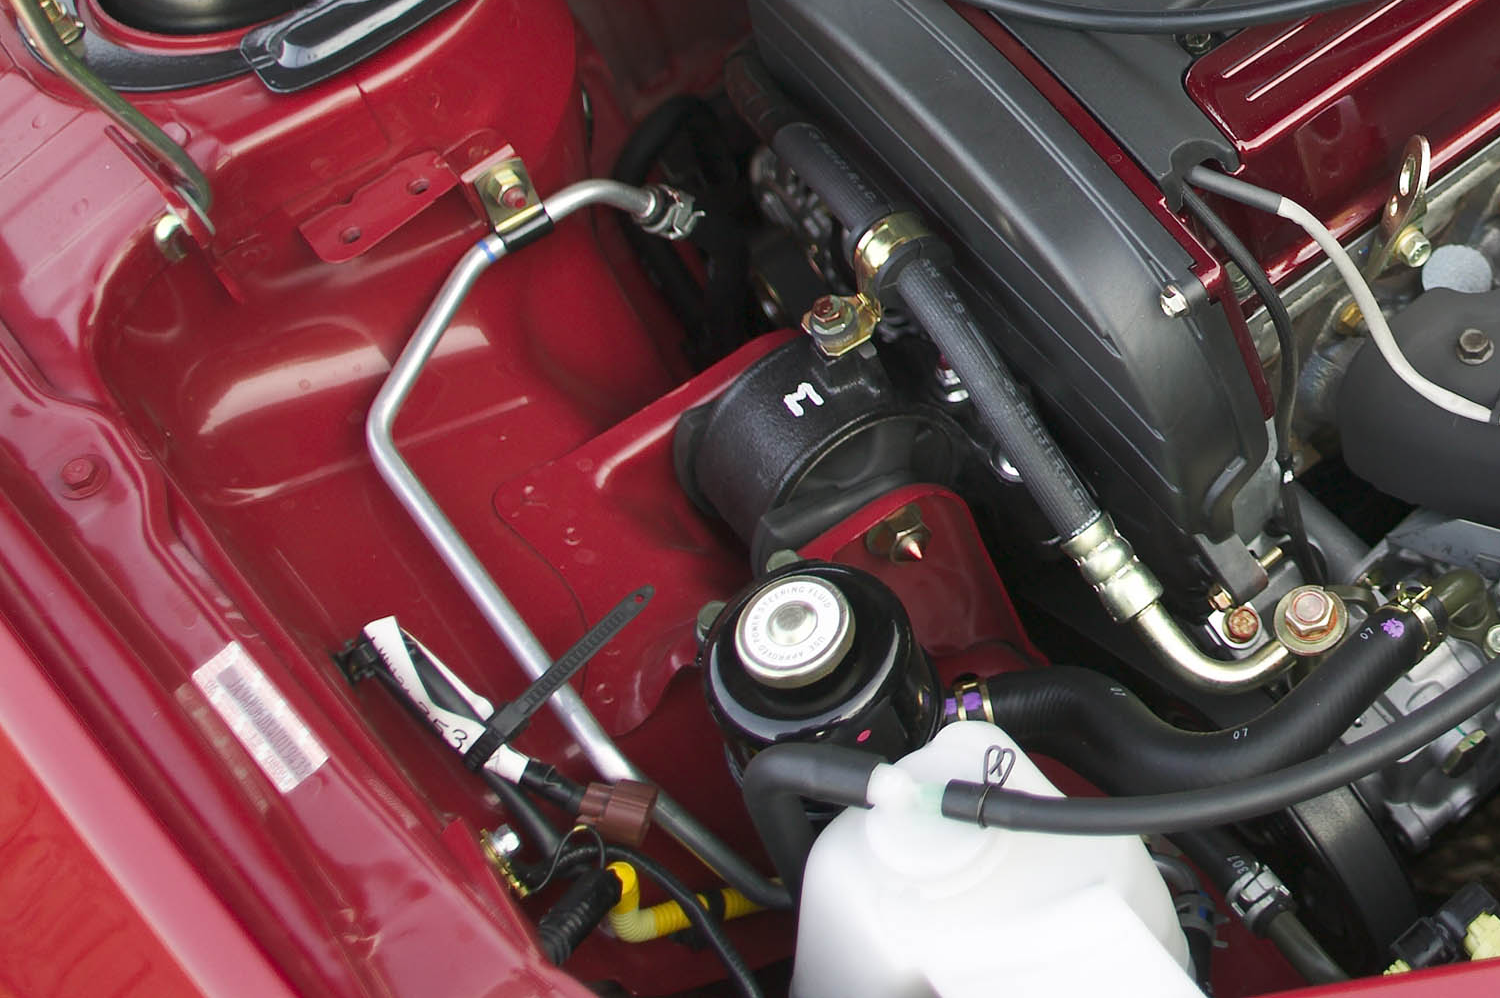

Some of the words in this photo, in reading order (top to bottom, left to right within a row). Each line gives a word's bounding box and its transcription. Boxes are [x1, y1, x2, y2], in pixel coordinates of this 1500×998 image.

[783, 382, 825, 417] M
[758, 586, 806, 612] STEERING
[807, 588, 832, 608] FLUID
[1359, 626, 1375, 640] 07
[808, 636, 826, 652] USE
[758, 645, 804, 661] APPROVED
[1232, 727, 1249, 741] 07
